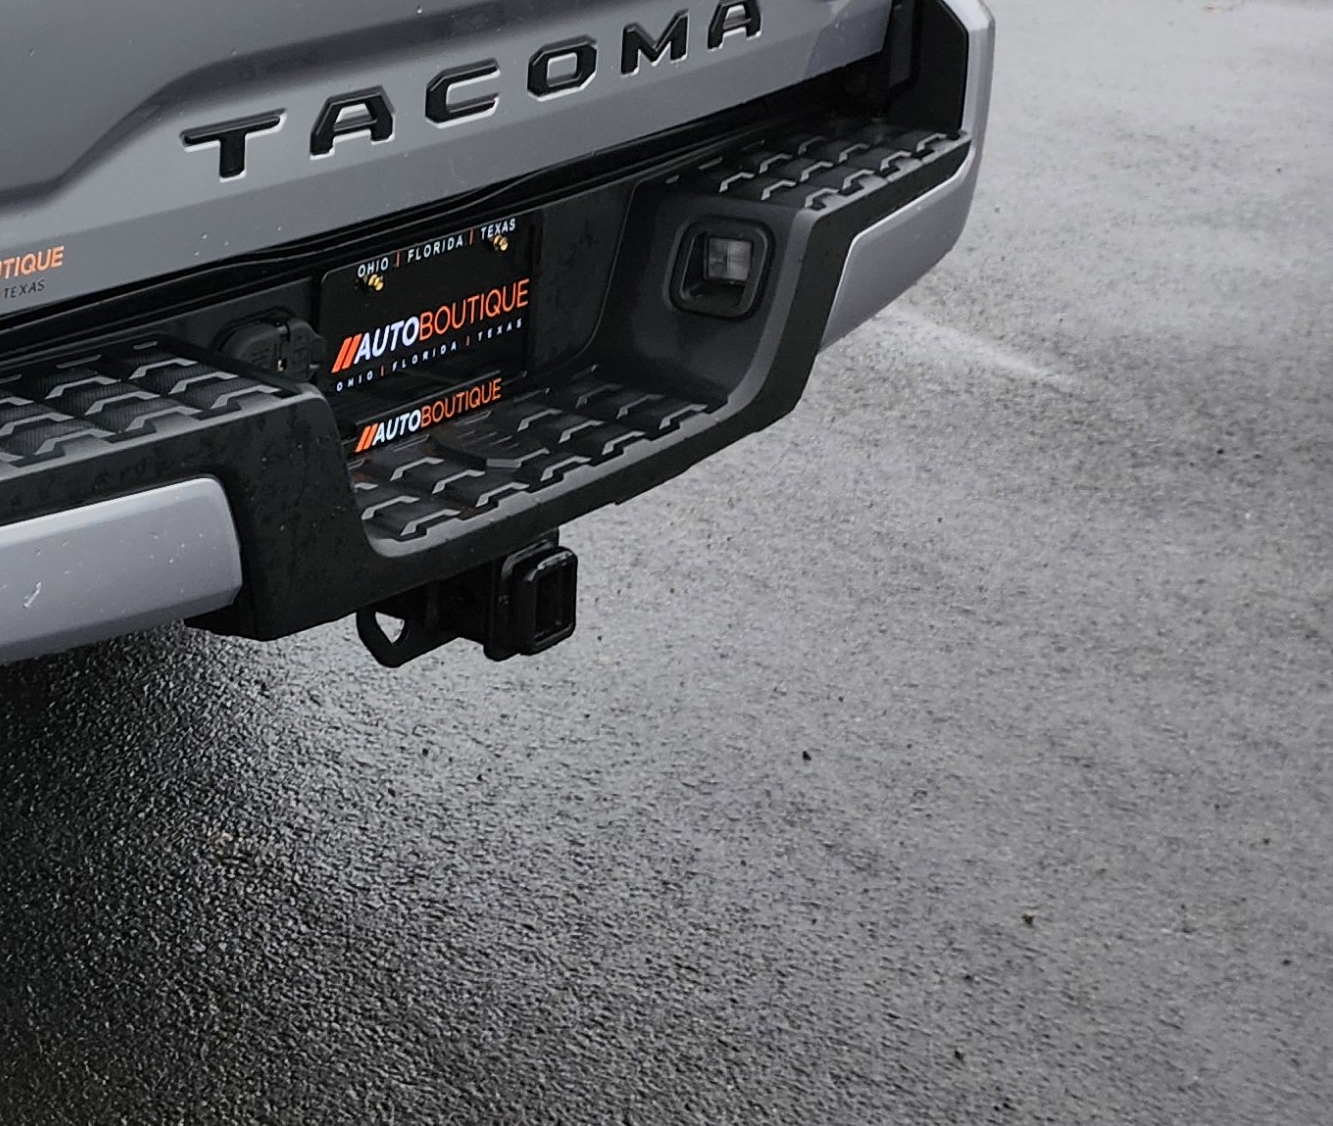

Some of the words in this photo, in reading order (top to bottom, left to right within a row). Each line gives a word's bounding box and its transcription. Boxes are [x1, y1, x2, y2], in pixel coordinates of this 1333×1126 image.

[357, 256, 390, 278] OHIO
[406, 234, 464, 264] FLORIDA
[480, 217, 517, 240] TEXAS
[3, 278, 46, 300] TEXAS
[352, 277, 530, 365] AUTOBOUTIQUE
[336, 369, 374, 393] OHIO
[391, 341, 458, 373] FLORIDA
[478, 317, 523, 342] TEXAS
[371, 377, 502, 447] AUTOBOUTIQUE
